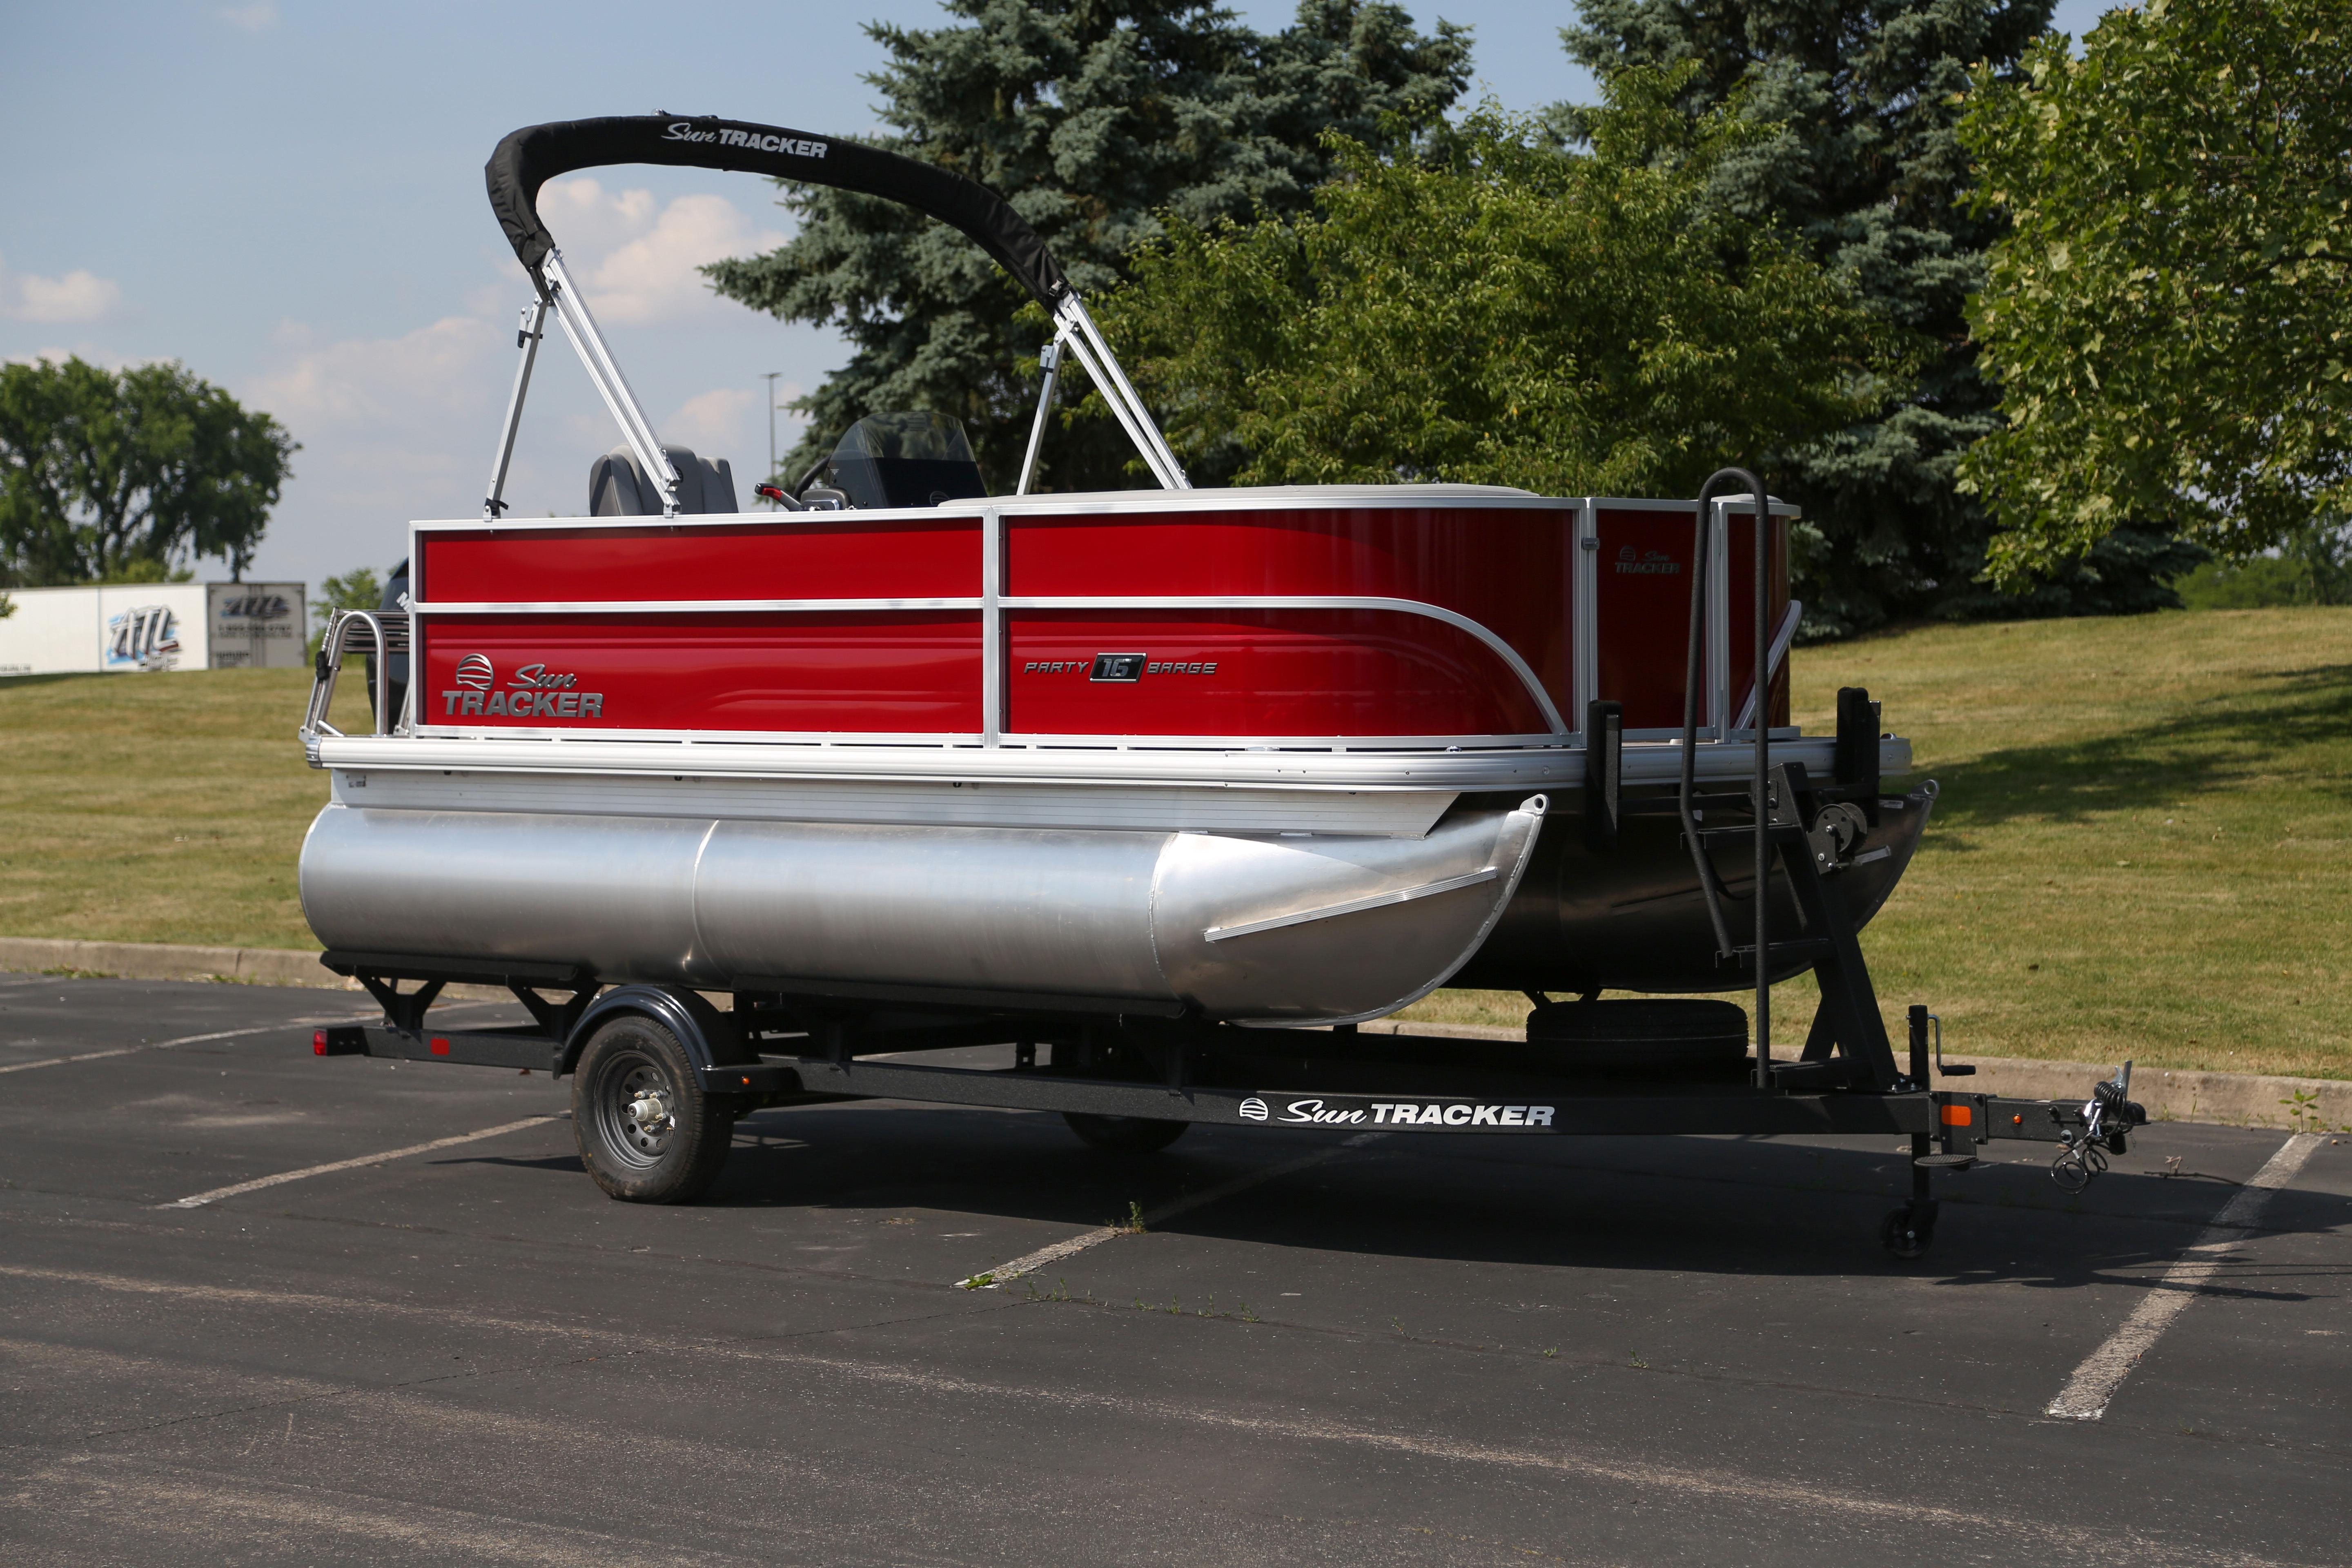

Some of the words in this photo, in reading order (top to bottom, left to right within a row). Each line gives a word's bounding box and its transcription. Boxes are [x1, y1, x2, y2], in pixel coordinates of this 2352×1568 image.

[661, 122, 717, 143] Sun
[719, 129, 828, 158] TRACKER
[1615, 562, 1681, 574] TRACKER
[1642, 551, 1670, 561] Sun
[507, 663, 577, 689] Sun
[1023, 662, 1089, 674] PARTY
[1102, 658, 1132, 677] 16
[1146, 662, 1218, 675] BARGE
[442, 690, 604, 718] TRACKER
[1276, 1100, 1368, 1125] Sun
[1371, 1103, 1555, 1126] TRACKER
